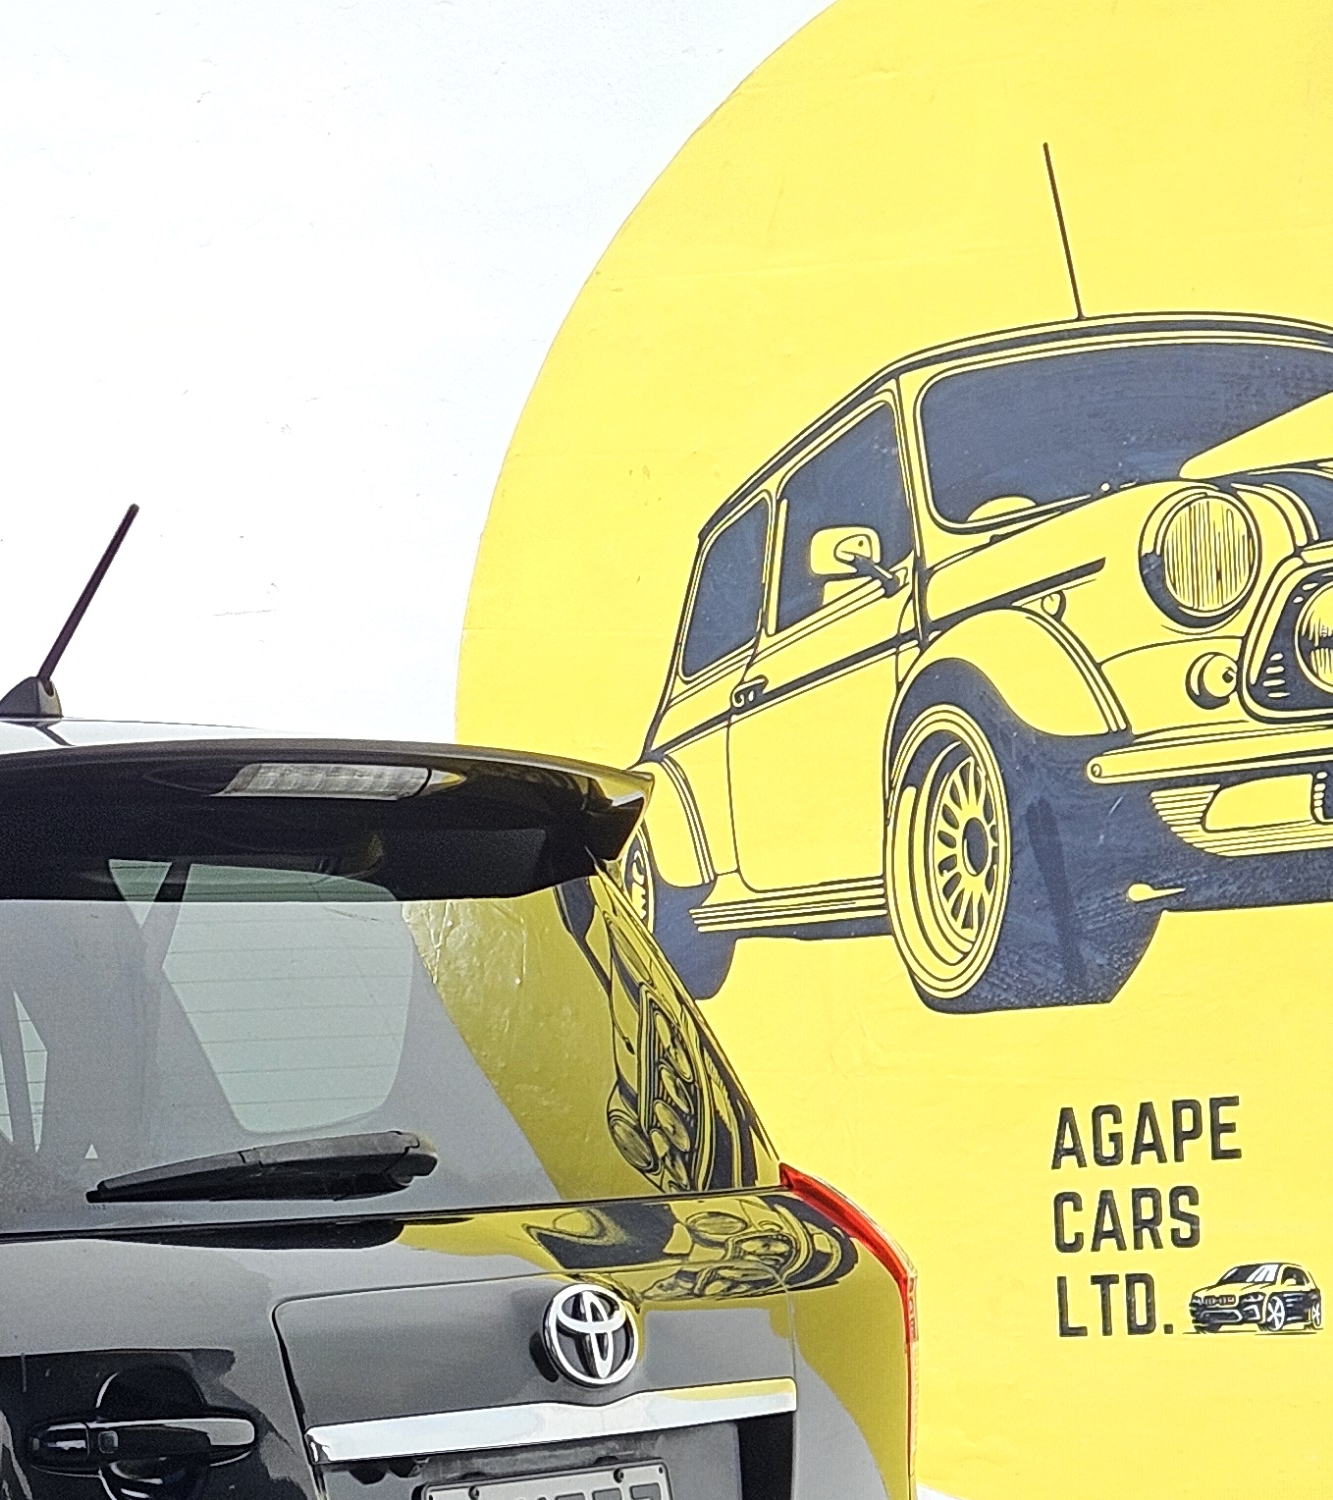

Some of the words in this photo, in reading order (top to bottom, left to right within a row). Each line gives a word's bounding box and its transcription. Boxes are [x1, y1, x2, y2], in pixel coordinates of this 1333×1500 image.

[1050, 1095, 1243, 1170] AGAPE
[1053, 1185, 1201, 1253] CARS
[1057, 1273, 1174, 1337] LTD.
